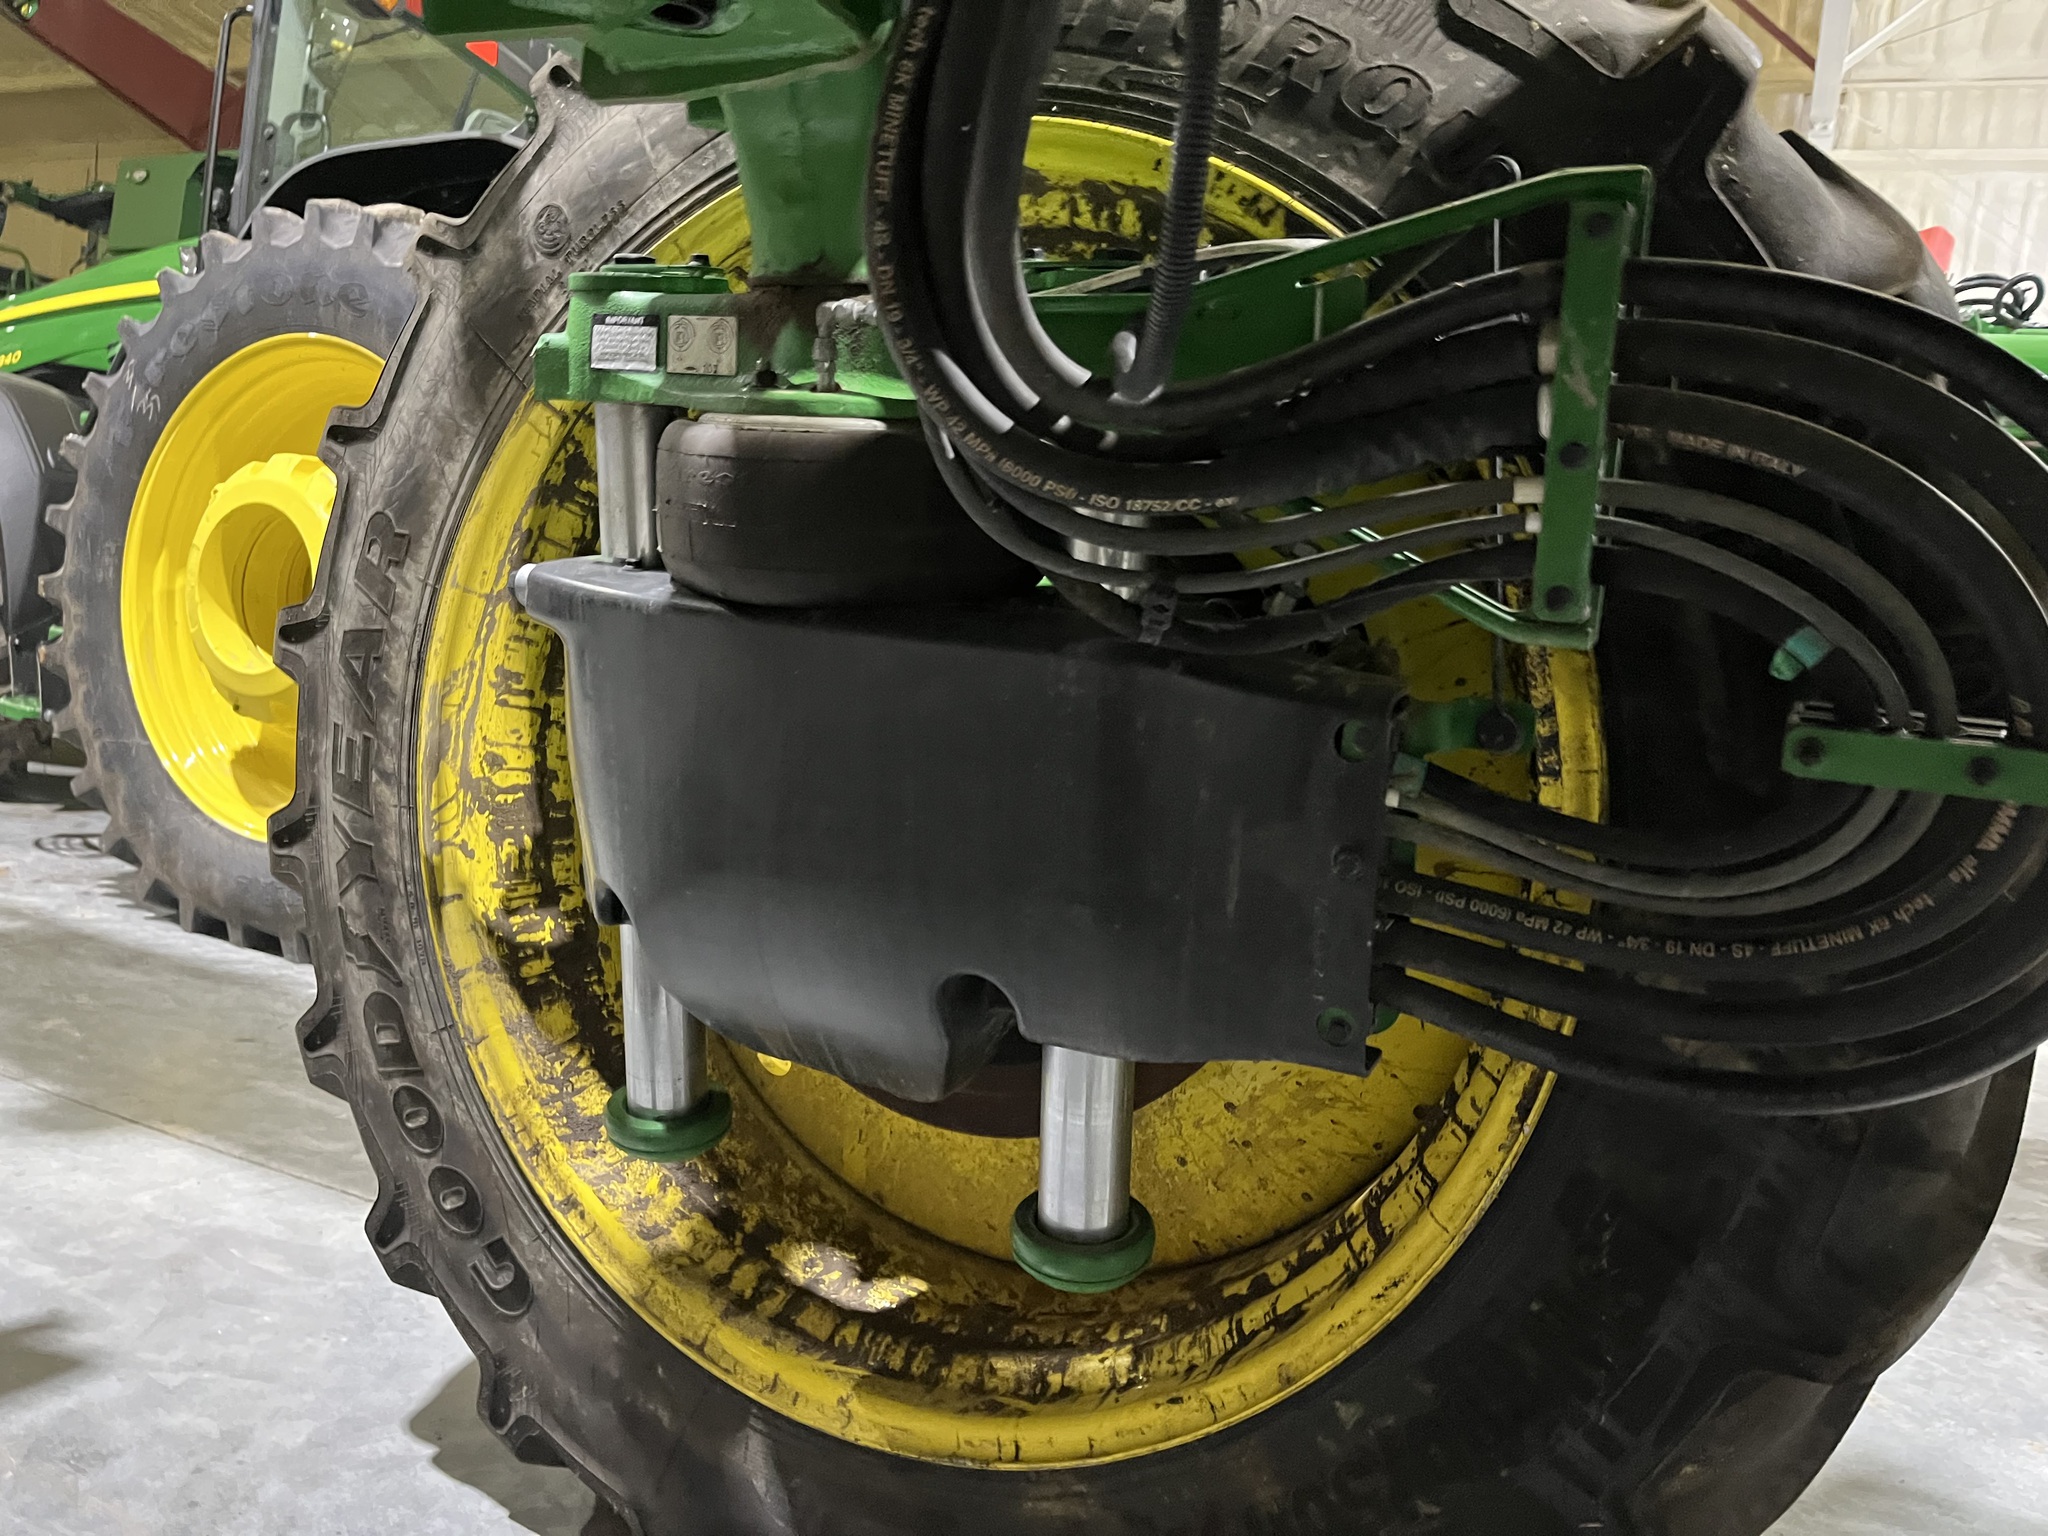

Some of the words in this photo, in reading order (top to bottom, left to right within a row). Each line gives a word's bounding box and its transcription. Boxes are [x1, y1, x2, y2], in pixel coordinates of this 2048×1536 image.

[873, 93, 907, 199] MINETUFF
[877, 265, 897, 295] DN
[924, 383, 950, 412] WP
[947, 415, 967, 435] 42
[963, 432, 997, 463] MPa
[998, 457, 1043, 488] (6000
[1088, 493, 1121, 509] ISO
[1125, 498, 1201, 512] 18752/CC
[1394, 880, 1422, 897] ISO
[1435, 890, 1467, 909] PSI)
[1893, 893, 1936, 924] tech
[329, 508, 533, 1318] GOODYEAR
[1469, 899, 1512, 922] (6000
[1516, 912, 1550, 932] MPa
[1552, 924, 1573, 936] 42
[1575, 927, 1604, 944] WP
[1771, 925, 1866, 957] MINETUFF
[1665, 940, 1683, 955] 19
[1689, 942, 1716, 958] DN
